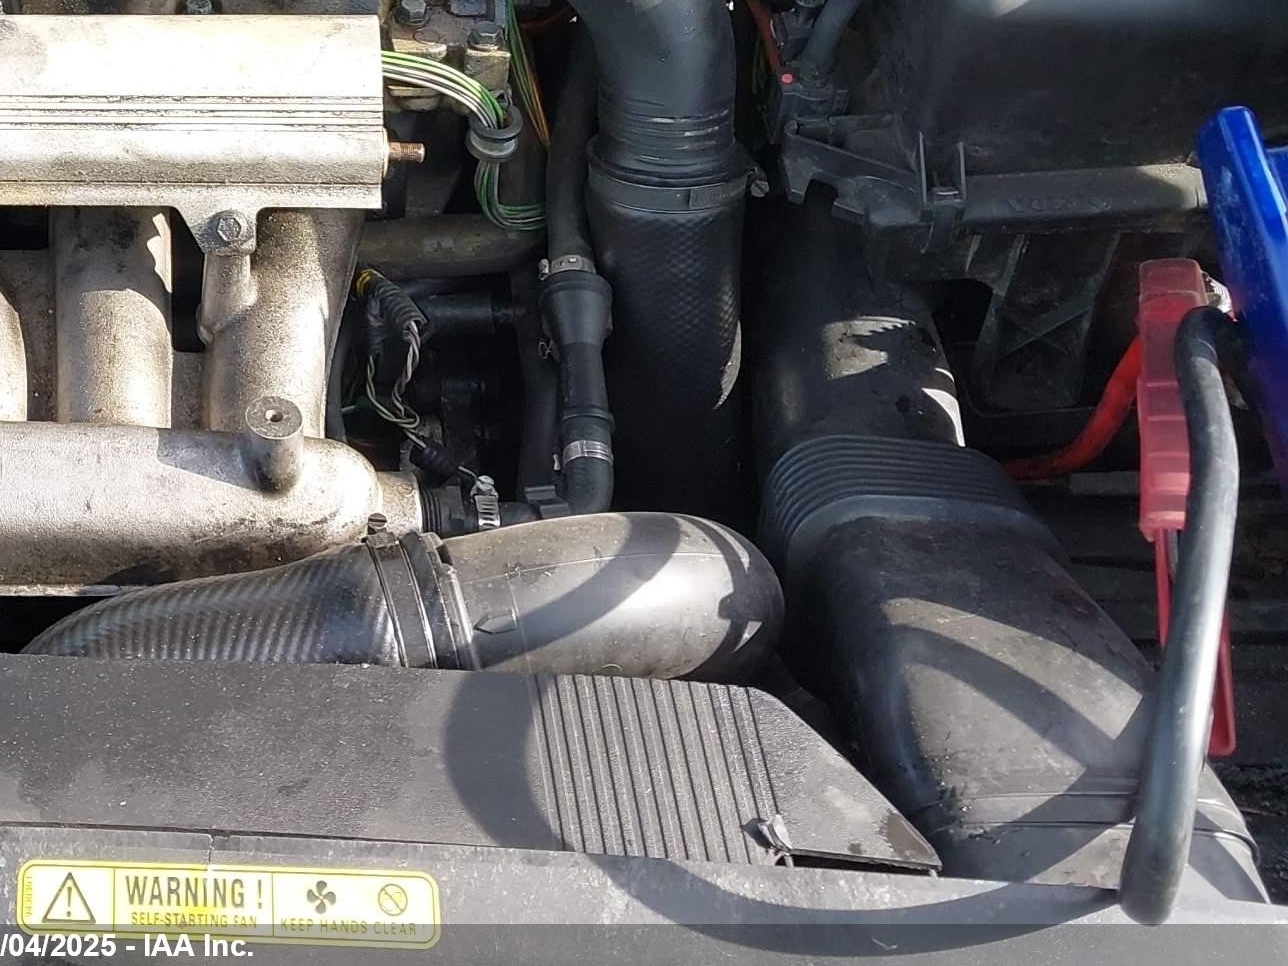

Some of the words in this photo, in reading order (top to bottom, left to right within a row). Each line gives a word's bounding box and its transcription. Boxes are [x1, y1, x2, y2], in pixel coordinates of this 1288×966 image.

[125, 875, 245, 909] WARNING
[131, 911, 228, 928] SELF-STARTING
[233, 915, 257, 930] FAN
[280, 918, 314, 932] KEEP
[319, 919, 368, 935] HANDS
[373, 921, 417, 936] CLEAR
